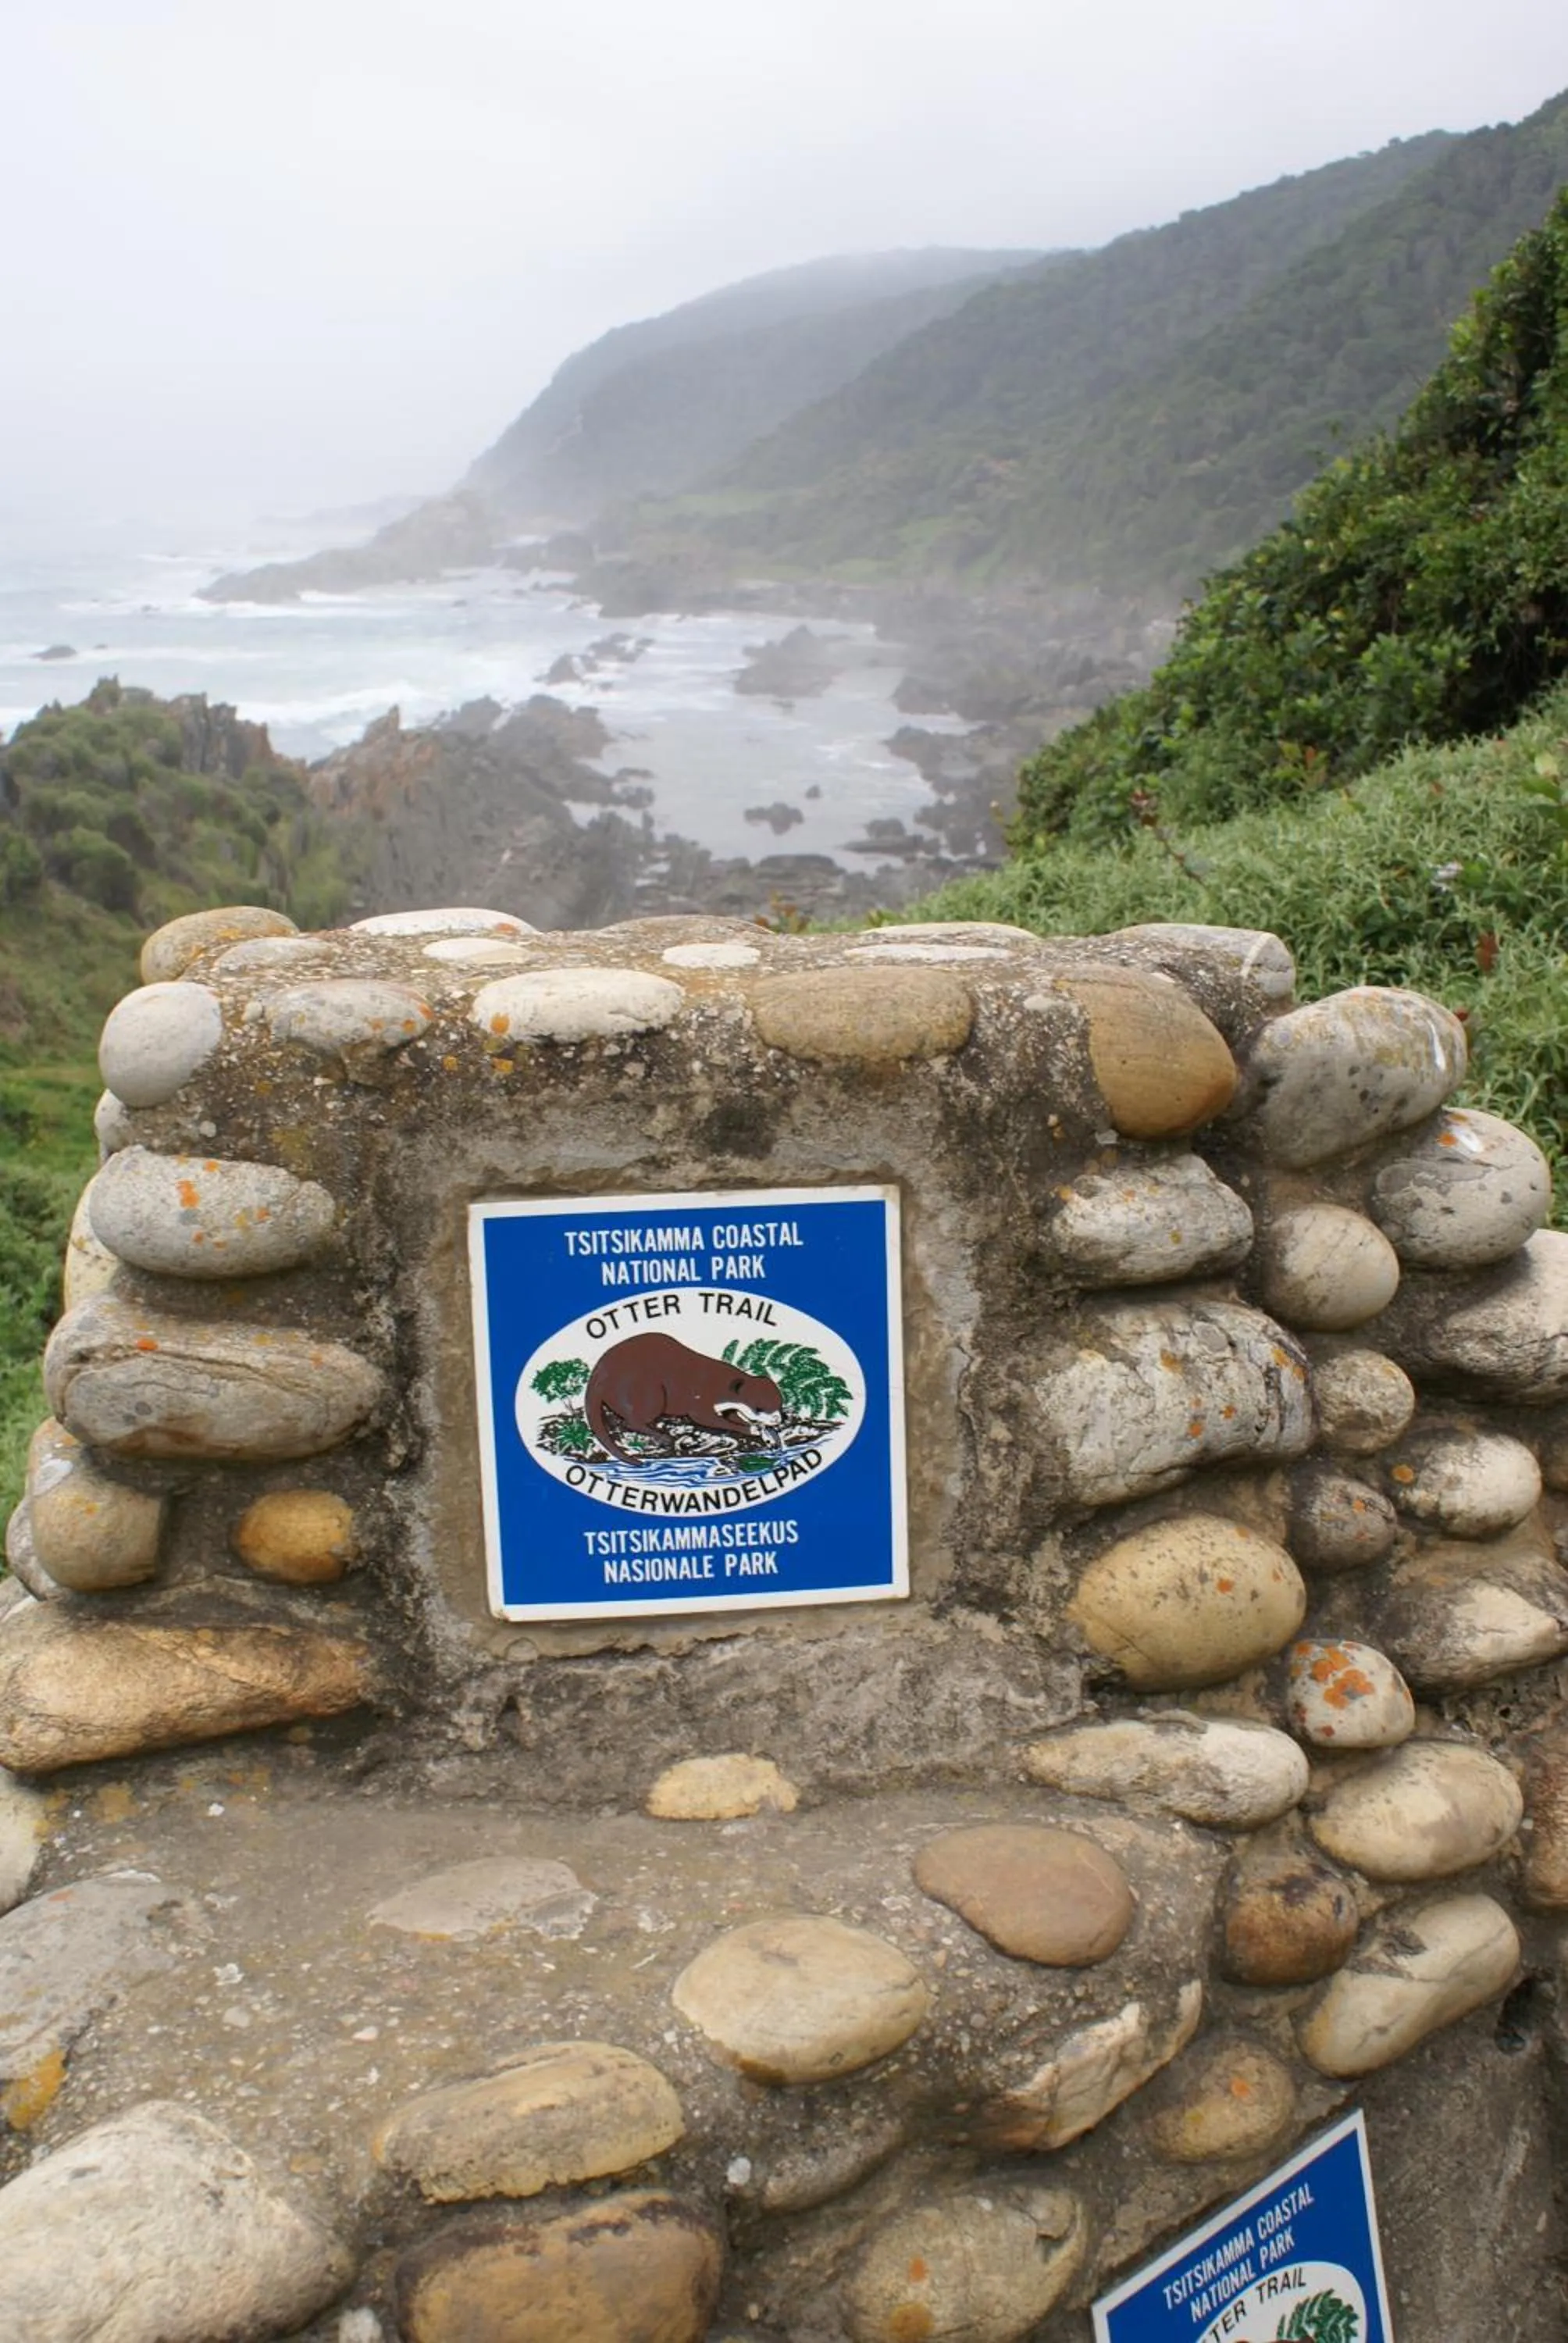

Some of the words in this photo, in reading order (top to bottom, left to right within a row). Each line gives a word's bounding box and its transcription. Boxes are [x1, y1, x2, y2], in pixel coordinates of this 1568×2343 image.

[565, 1227, 704, 1256] TSITSIKAMMA
[713, 1222, 804, 1250] COASTAL
[601, 1257, 700, 1286] NATIONAL
[711, 1254, 765, 1279] PARK
[586, 1294, 681, 1339] OTTER
[699, 1293, 779, 1327] TRAIL
[565, 1448, 822, 1514] OTTERWANDELPAD
[584, 1520, 798, 1555] TSITSIKAMMASEEKUS
[604, 1555, 715, 1584] NASIONALE
[725, 1551, 779, 1577] PARK
[1163, 2227, 1255, 2309] TSITSIKAMMA
[1256, 2182, 1314, 2238] COASTAL
[1190, 2257, 1256, 2323] NATIONAL
[1260, 2229, 1295, 2270] PARK
[1203, 2300, 1247, 2343] TER
[1256, 2267, 1306, 2304] TRAIL
